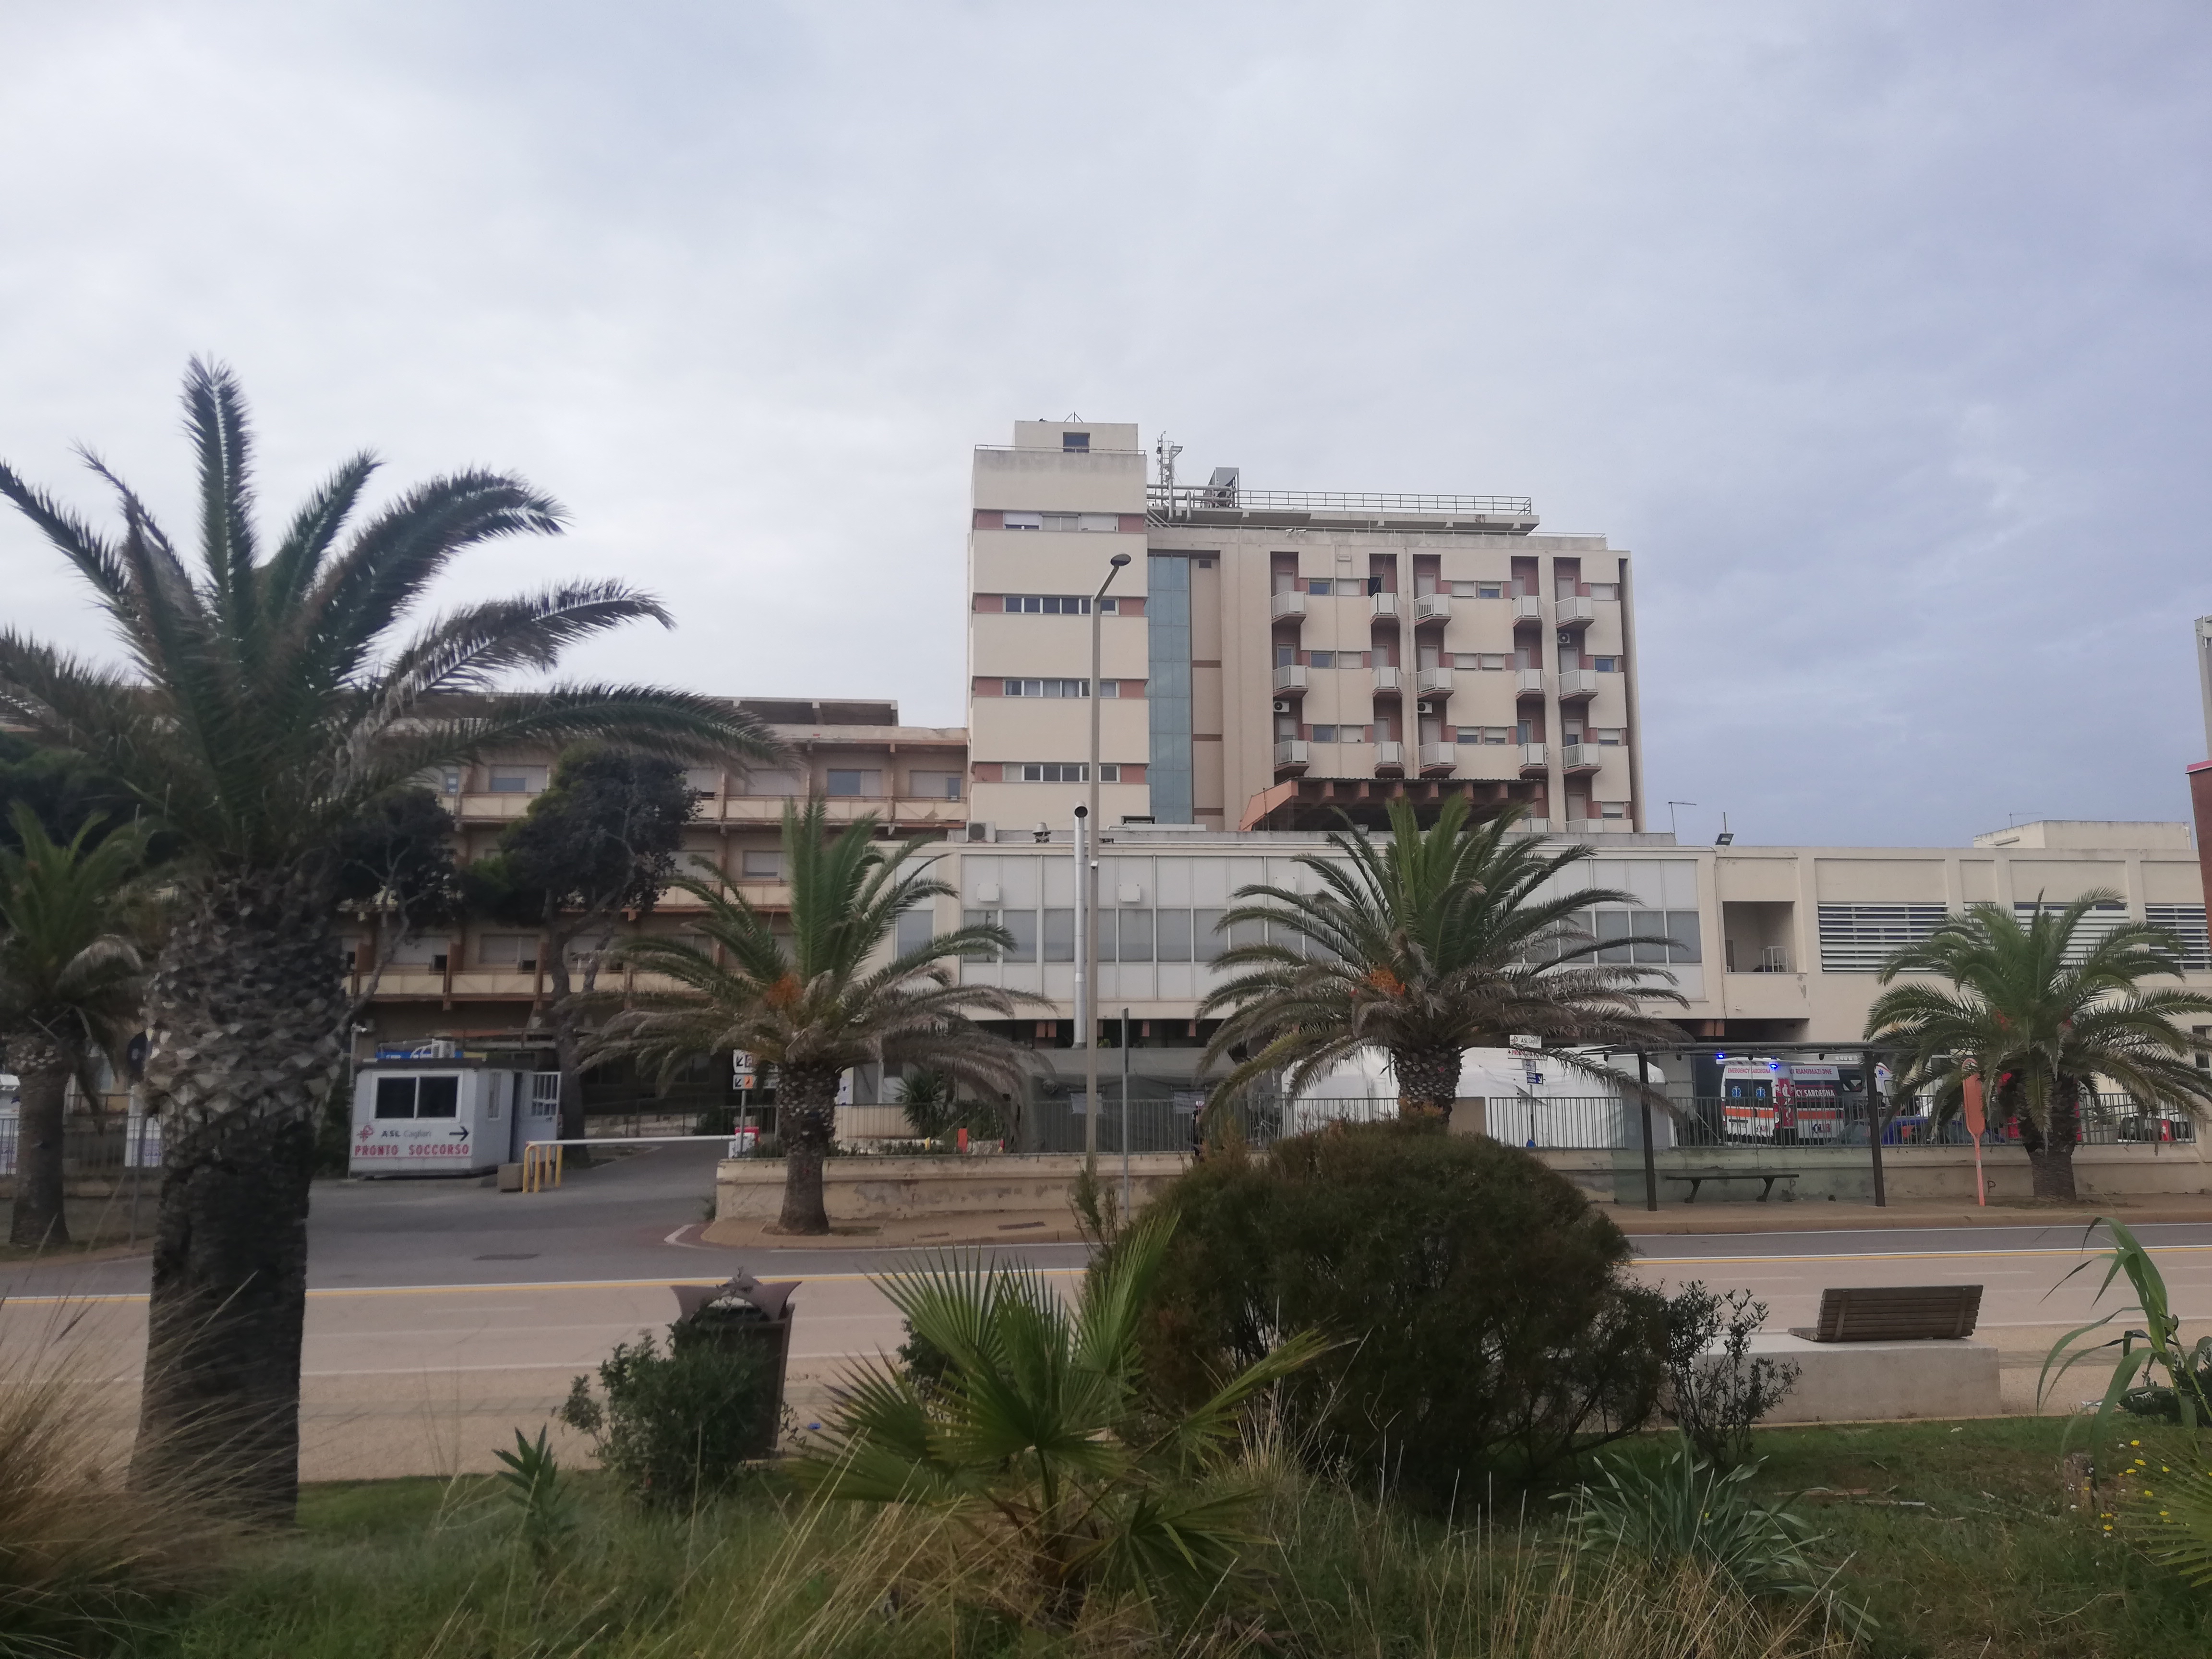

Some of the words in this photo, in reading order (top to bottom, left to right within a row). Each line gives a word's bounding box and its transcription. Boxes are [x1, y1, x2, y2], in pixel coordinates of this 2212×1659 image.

[403, 1129, 431, 1139] Cagliari
[355, 1144, 399, 1156] PRONTO
[409, 1144, 469, 1156] SOCCORSO
